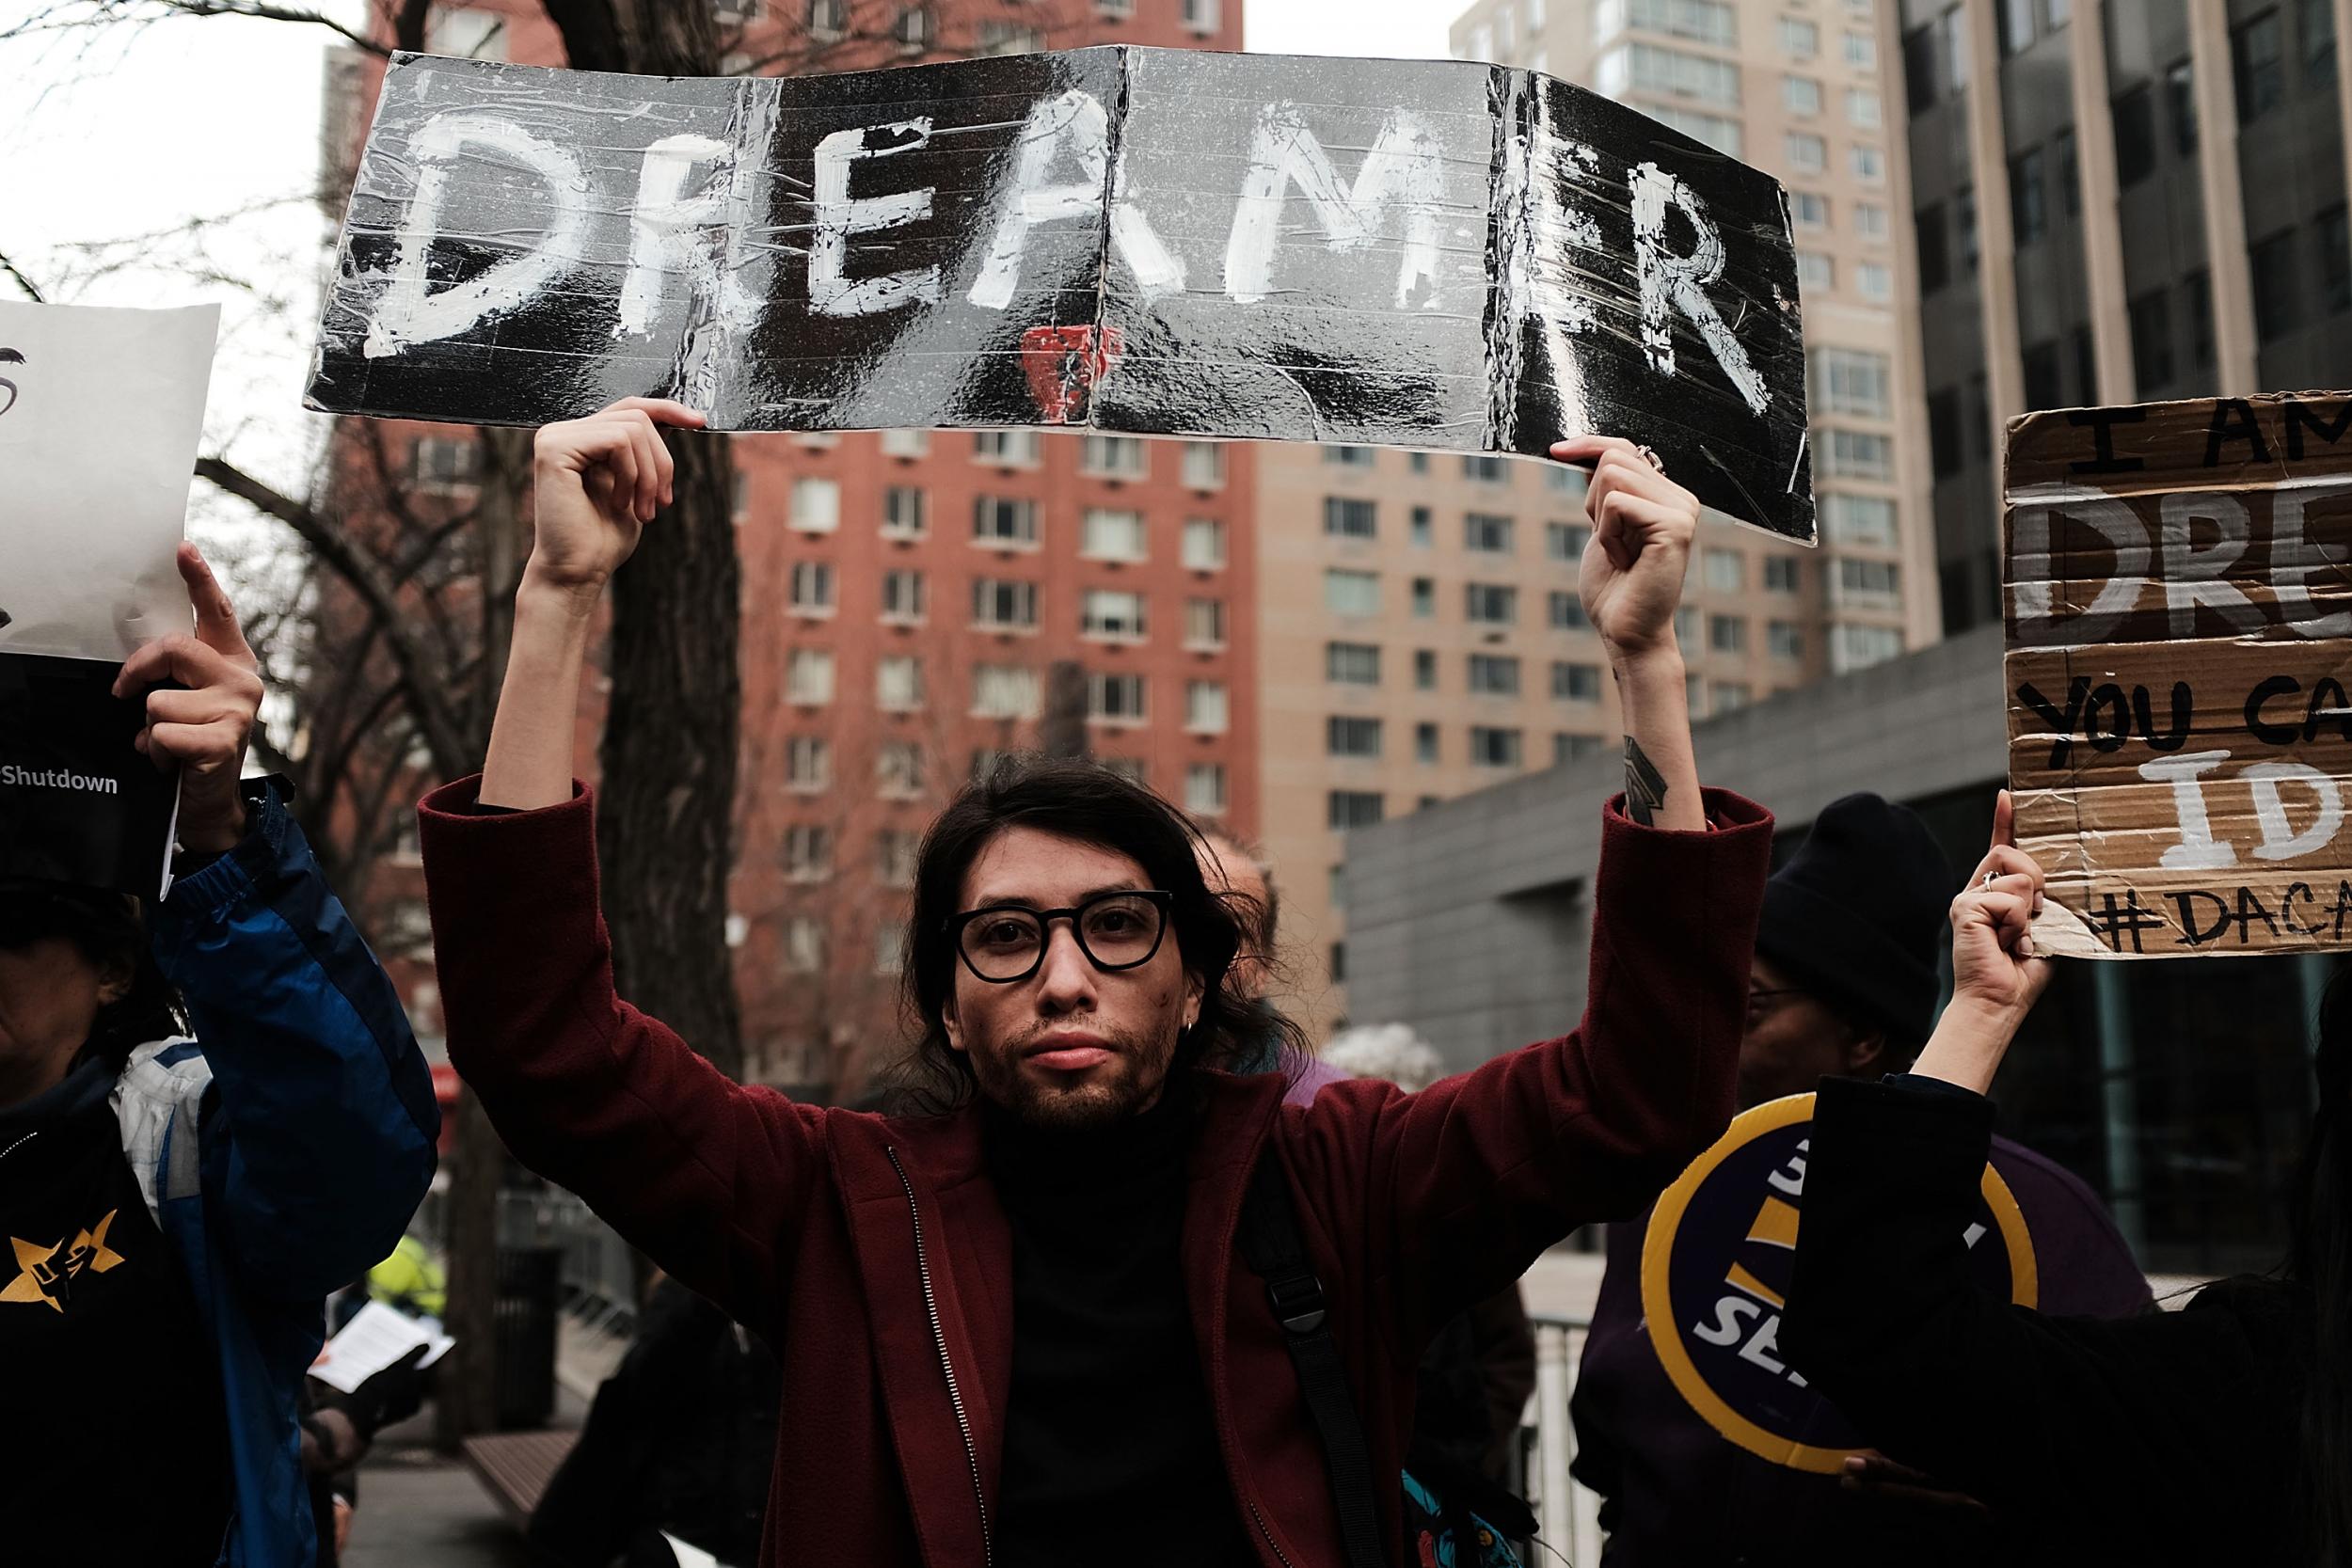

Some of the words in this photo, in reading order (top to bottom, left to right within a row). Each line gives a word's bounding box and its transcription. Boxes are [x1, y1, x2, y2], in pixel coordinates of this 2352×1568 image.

[363, 87, 1772, 416] DREAMER
[2067, 406, 2146, 474] I
[2015, 675, 2193, 769] YOU
[0, 765, 119, 795] Shutdown
[2137, 750, 2345, 870] ID
